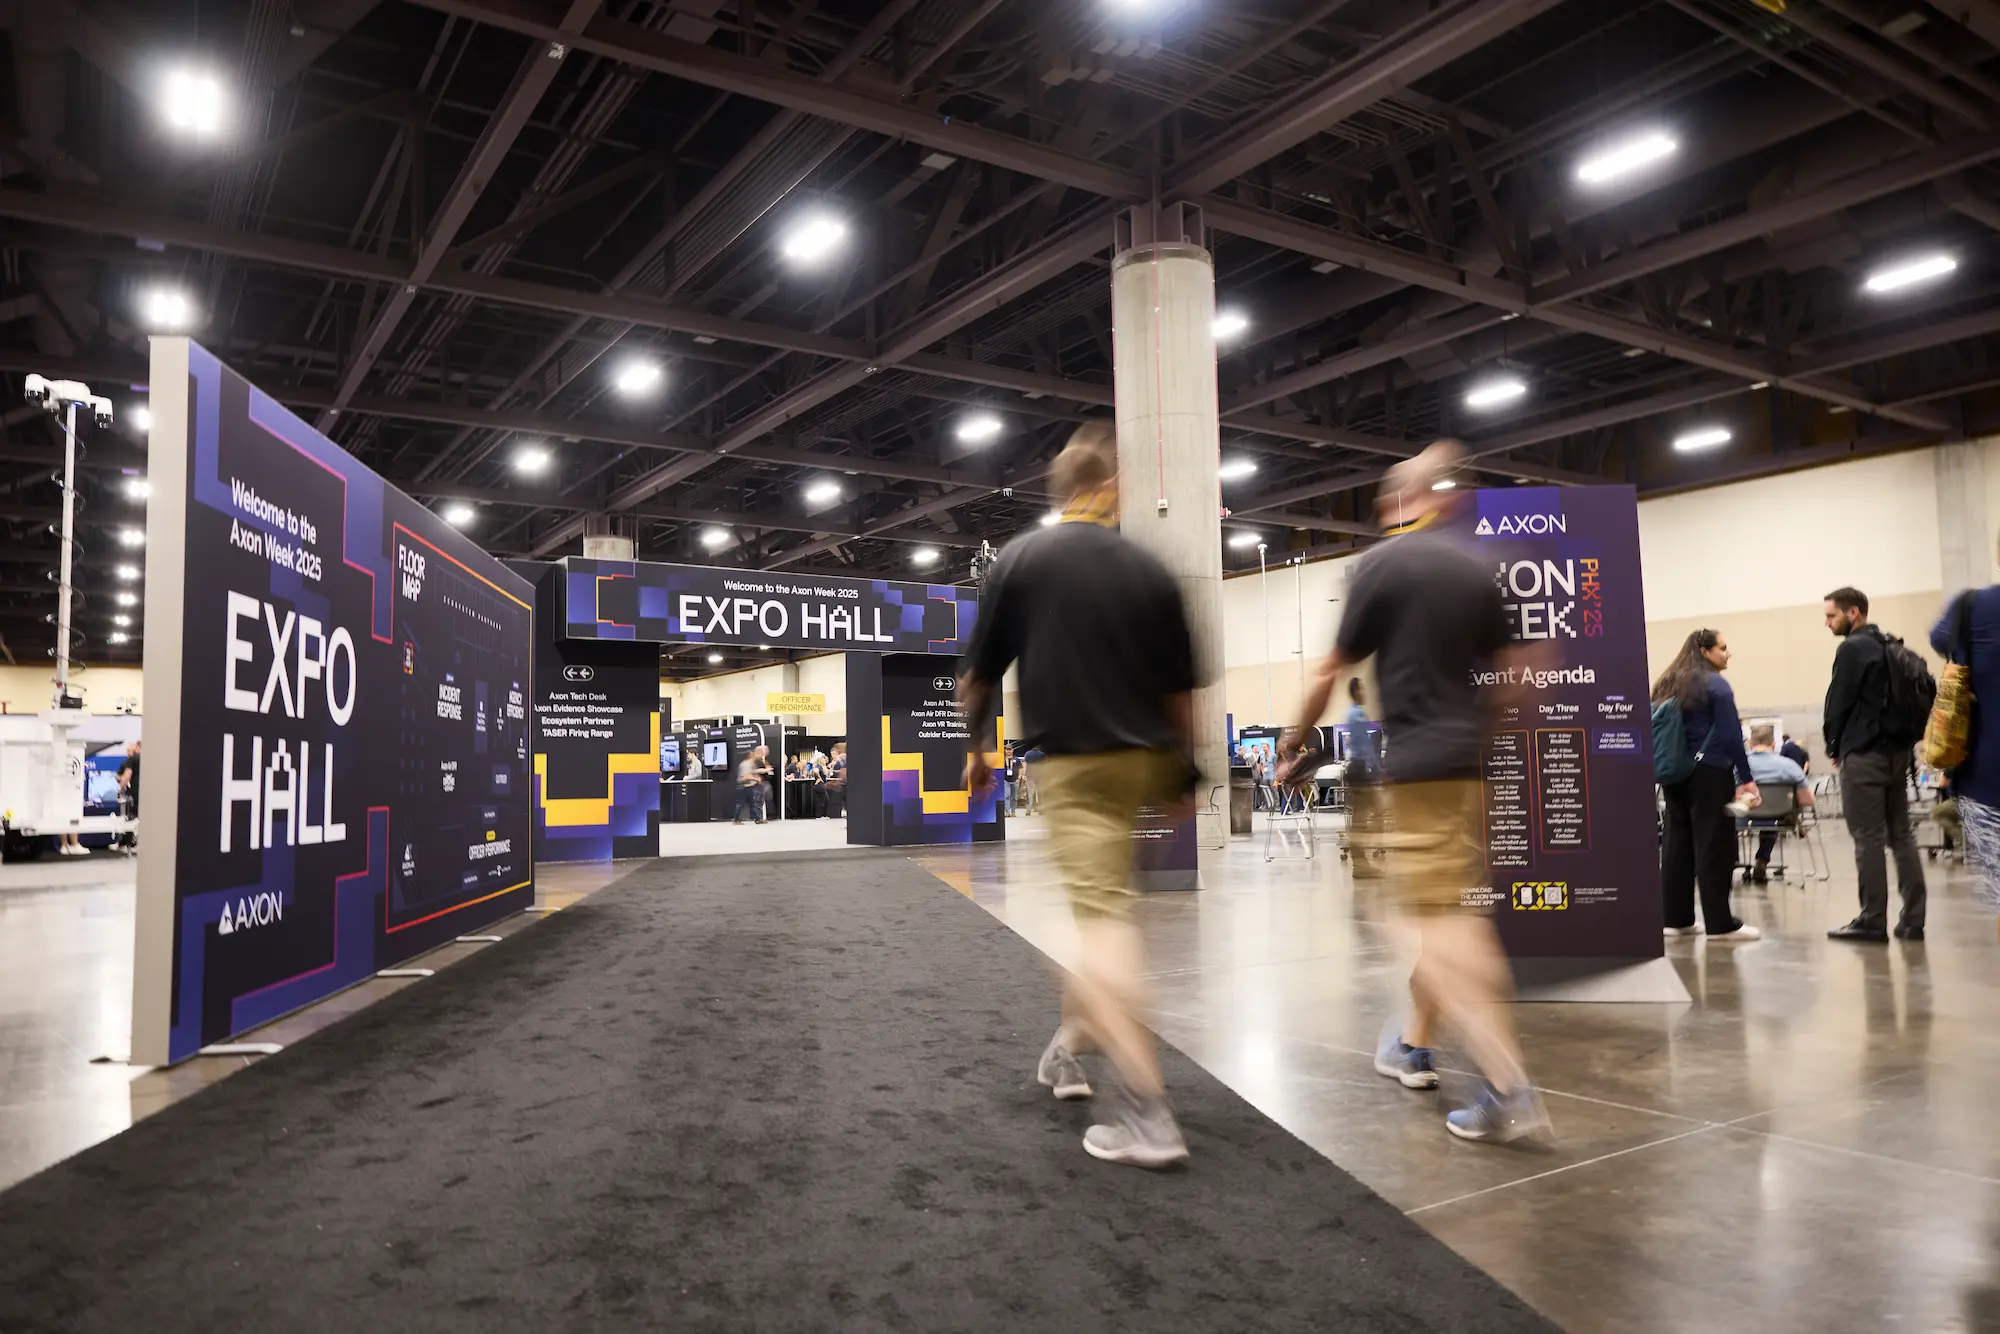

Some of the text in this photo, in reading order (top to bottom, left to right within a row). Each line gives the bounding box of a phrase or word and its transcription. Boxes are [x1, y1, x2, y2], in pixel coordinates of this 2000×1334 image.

[232, 477, 317, 545] Welcome to the
[1497, 514, 1566, 534] AXON
[230, 518, 322, 581] Axon Week 2025
[399, 544, 426, 581] FLOOR
[402, 572, 421, 602] MAP
[1494, 559, 1576, 598] ON
[724, 580, 859, 599] Welcome to the Axon Week 2025
[679, 594, 894, 642] EXPO HALL
[1502, 601, 1577, 639] EEK
[225, 589, 357, 726] EXPO
[1520, 665, 1596, 688] Agenda
[439, 683, 461, 703] INCIDENT
[549, 692, 607, 701] Axon Tech Desk
[782, 696, 811, 704] OFFICER
[437, 700, 462, 720] RESPONSE
[553, 704, 586, 713] Evidence
[587, 705, 624, 714] Showcase
[770, 704, 823, 712] PERFORMANCE
[1539, 704, 1579, 714] Day Three
[1598, 702, 1634, 714] Day Four
[542, 716, 614, 726] Ecosystem Partners
[946, 722, 967, 730] Training
[542, 728, 614, 738] TASER Firing Range
[942, 732, 971, 740] Experience
[220, 733, 346, 853] HALL
[234, 891, 283, 932] AXON
